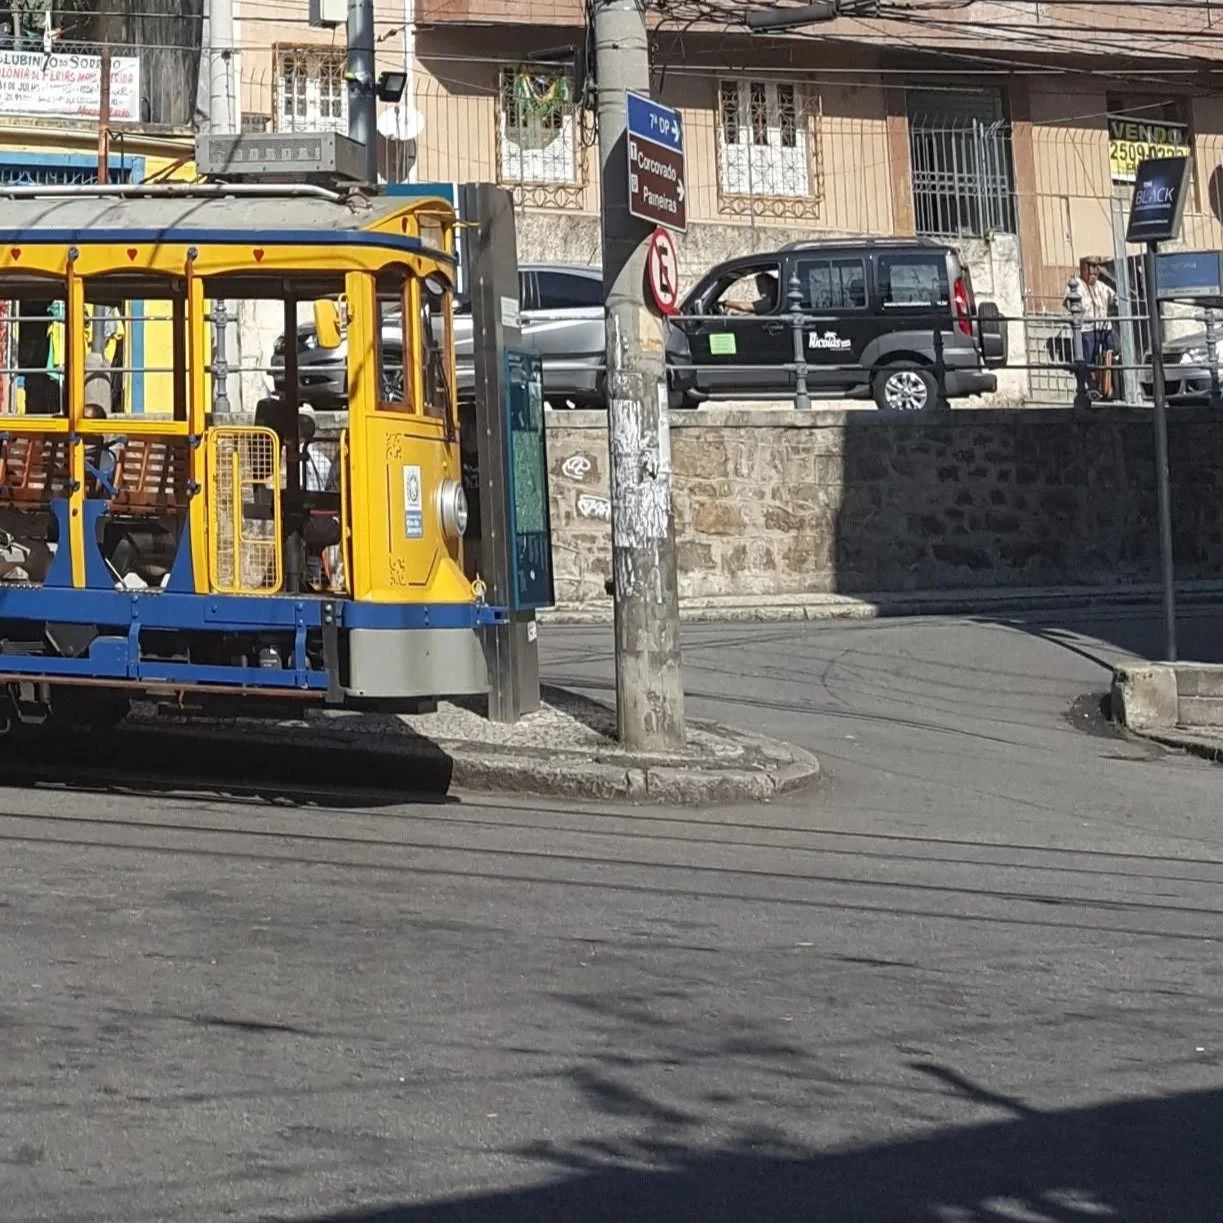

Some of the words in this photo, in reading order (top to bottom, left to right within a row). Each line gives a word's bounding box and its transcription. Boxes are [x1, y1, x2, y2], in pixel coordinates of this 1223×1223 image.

[70, 55, 120, 69] SORRO
[649, 113, 658, 129] 7ª
[659, 116, 670, 135] DP
[1111, 122, 1183, 146] VENDO
[637, 151, 677, 182] Corcovado
[643, 186, 677, 214] Paineiras
[1135, 186, 1174, 206] BLACK
